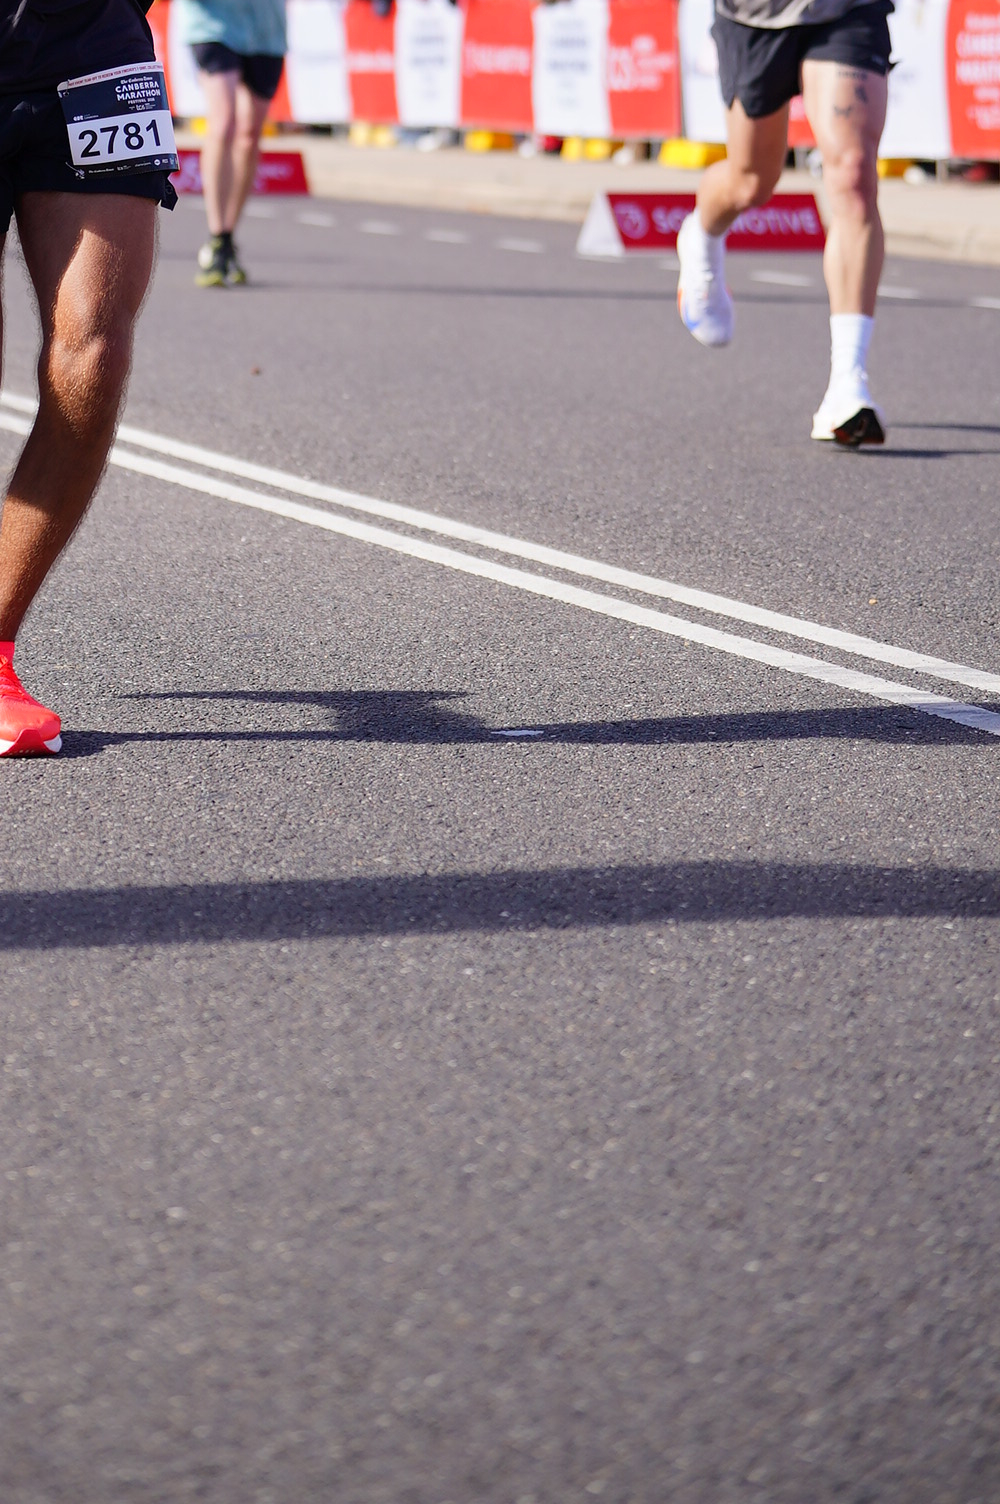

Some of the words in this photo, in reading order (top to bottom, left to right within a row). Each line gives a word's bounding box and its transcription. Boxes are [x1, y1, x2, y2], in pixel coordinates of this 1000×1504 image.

[115, 81, 160, 93] CANBERRA
[116, 89, 161, 102] MARATHON
[78, 119, 161, 158] 2781
